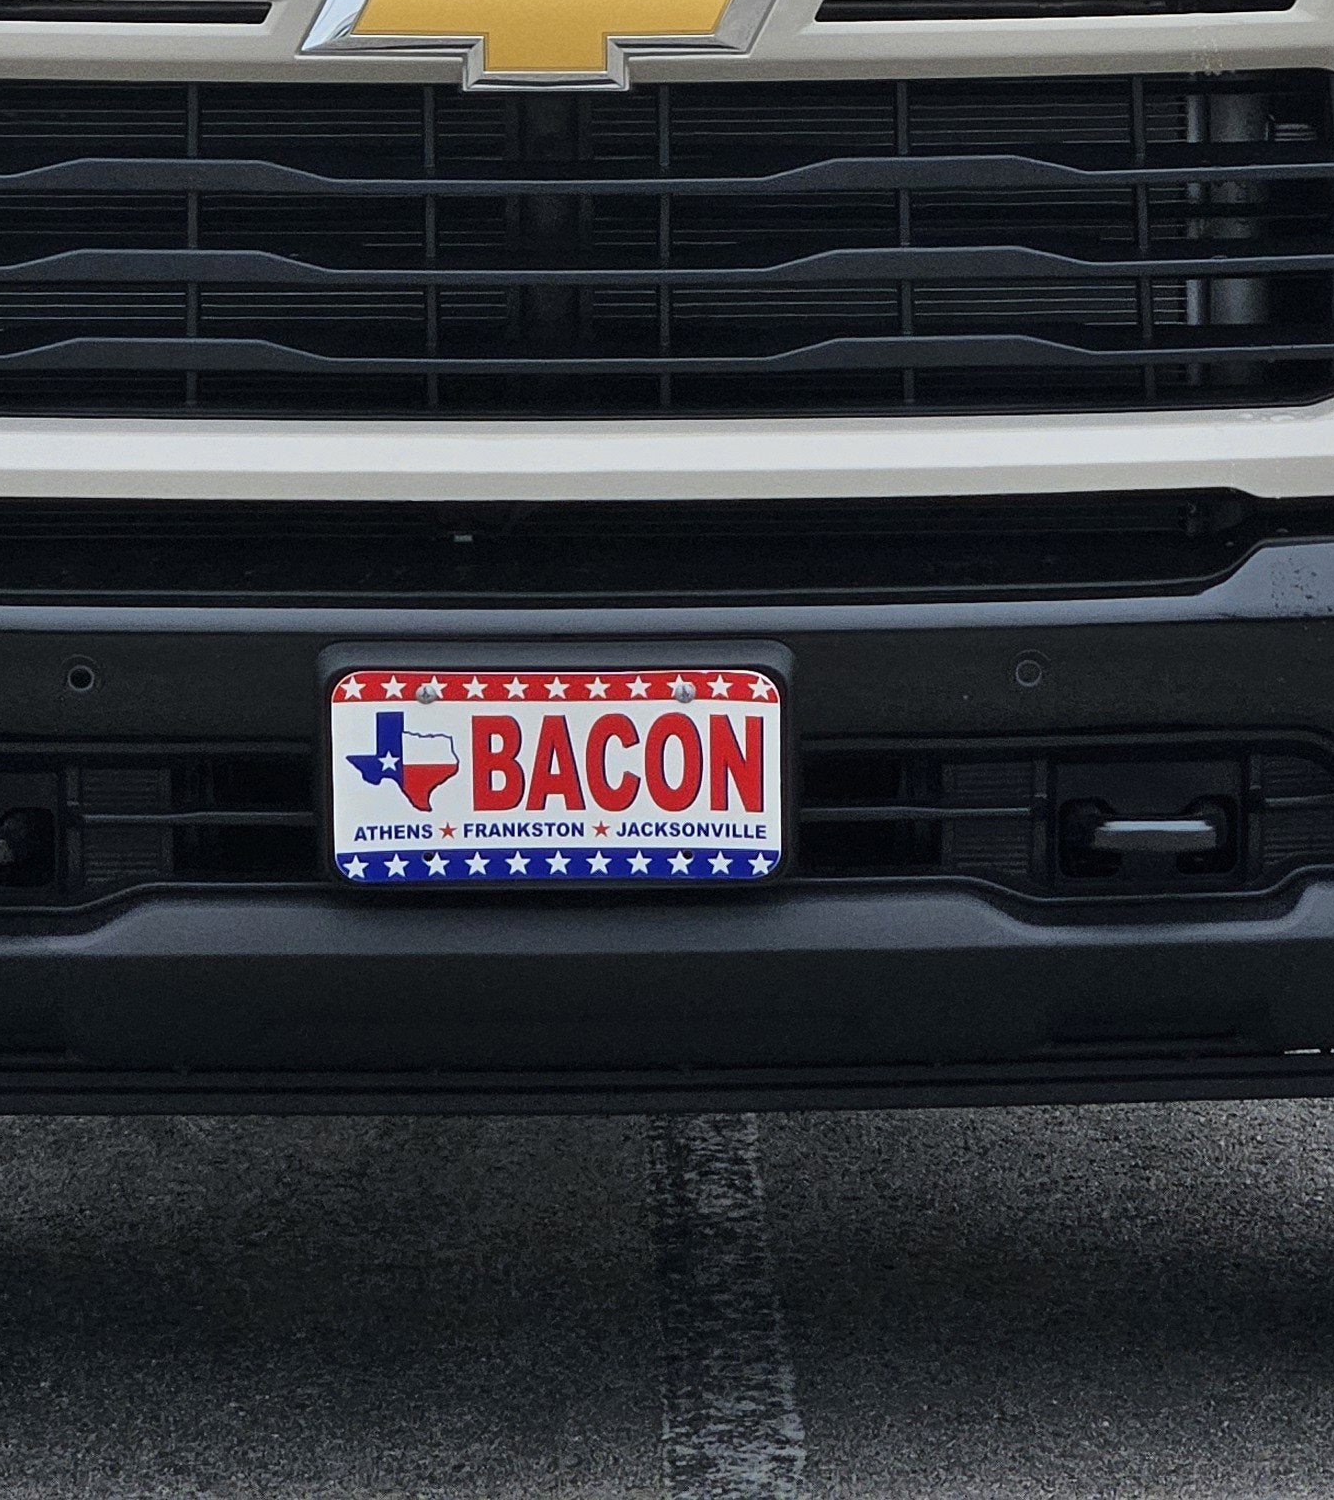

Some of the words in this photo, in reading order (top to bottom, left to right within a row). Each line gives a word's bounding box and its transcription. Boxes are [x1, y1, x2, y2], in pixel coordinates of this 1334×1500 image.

[471, 713, 765, 812] BACON
[353, 823, 433, 842] ATHENS
[463, 821, 585, 839] FRANKSTON
[616, 821, 767, 840] JACKSONVILLE
